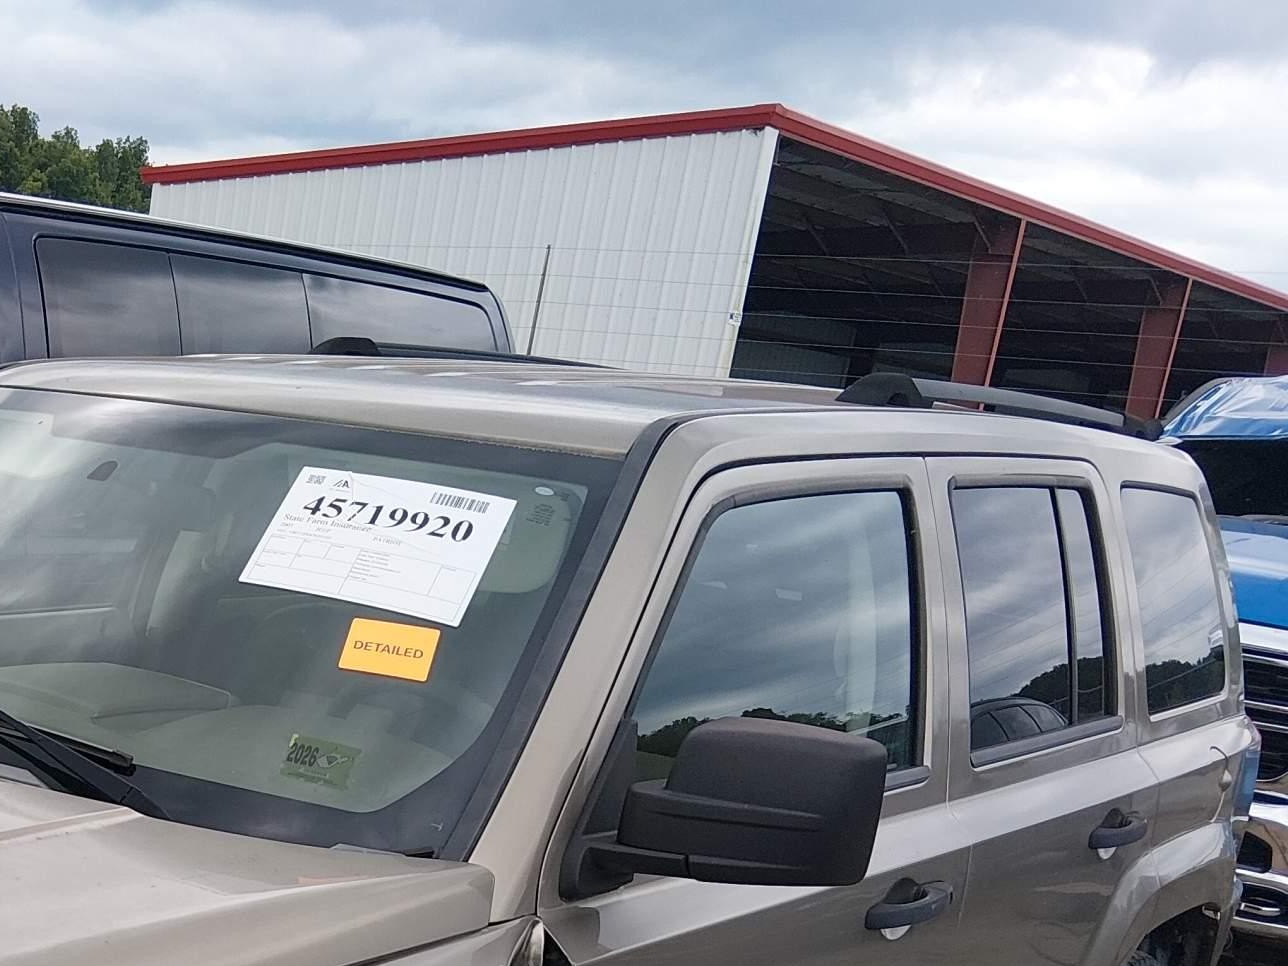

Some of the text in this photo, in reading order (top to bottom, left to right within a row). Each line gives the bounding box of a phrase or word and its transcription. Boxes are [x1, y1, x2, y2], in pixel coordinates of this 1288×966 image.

[283, 513, 373, 532] State Farm Insurance
[303, 495, 474, 543] 45719920
[353, 640, 424, 659] DETAILED
[286, 743, 320, 767] 2026
